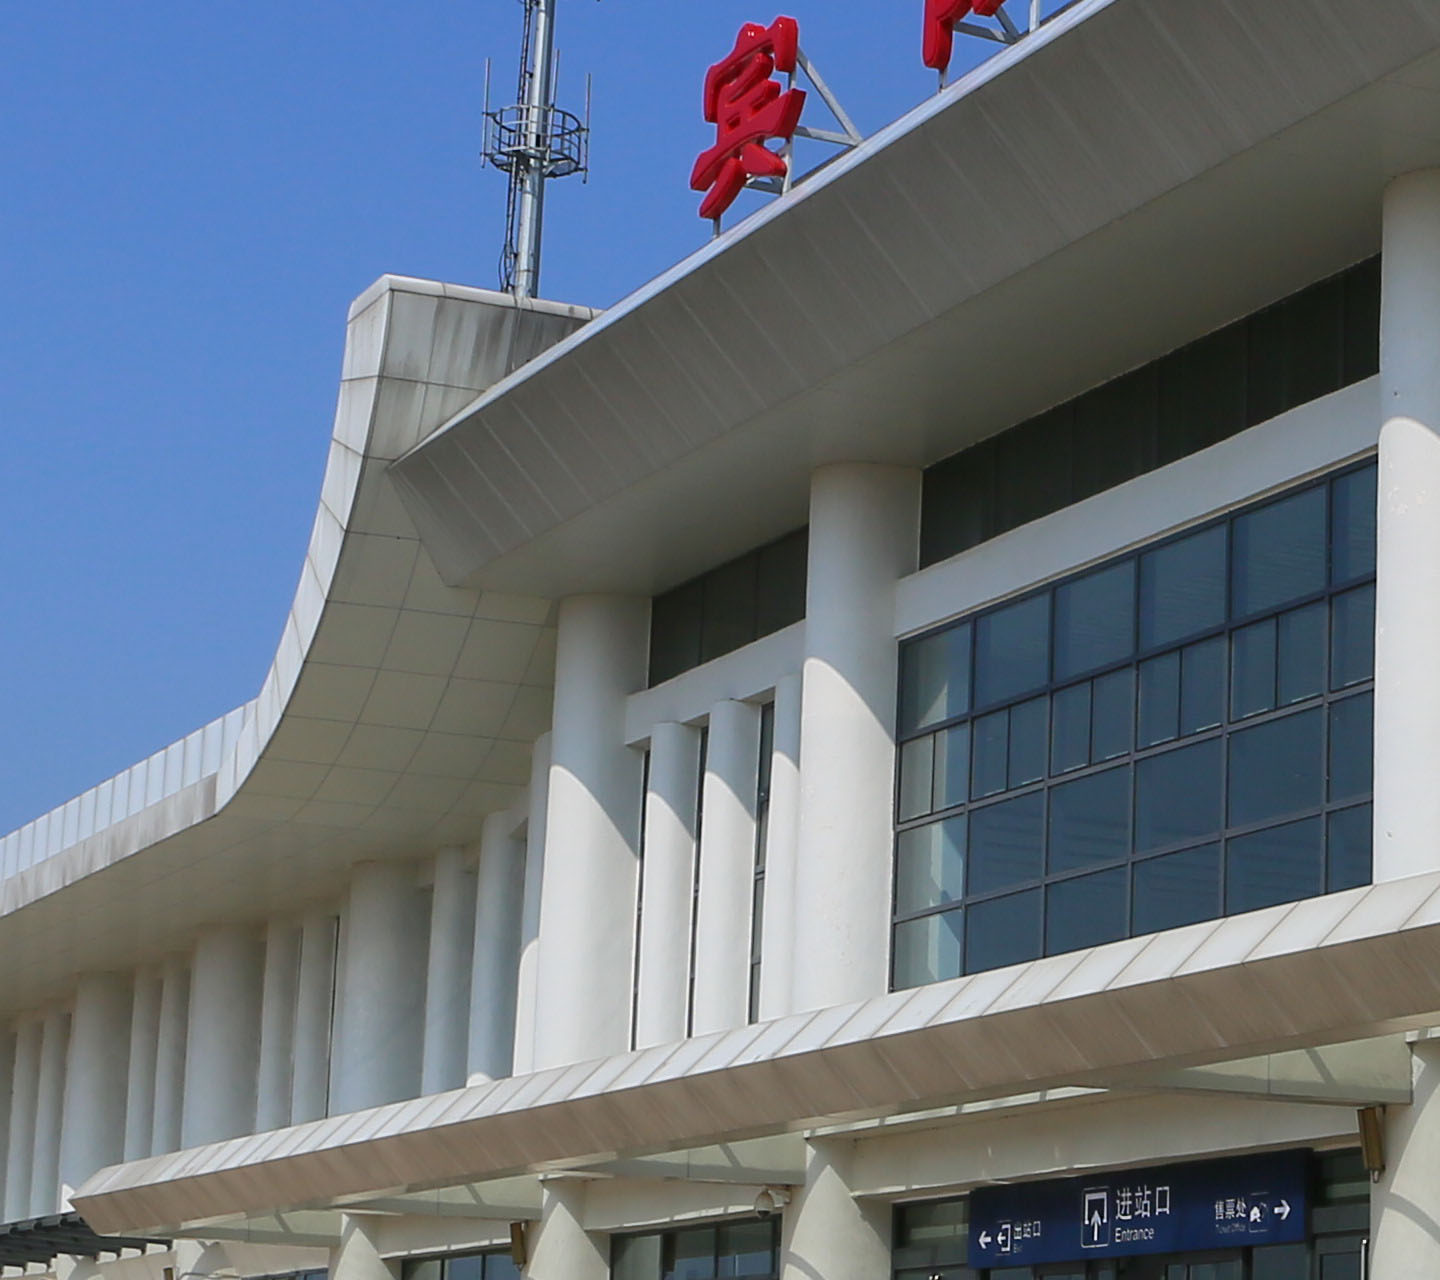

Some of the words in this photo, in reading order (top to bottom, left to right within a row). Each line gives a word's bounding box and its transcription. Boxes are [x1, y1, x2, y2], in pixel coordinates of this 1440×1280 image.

[1115, 1185, 1170, 1220] 进站口
[1215, 1197, 1247, 1220] 售票处
[1115, 1227, 1155, 1242] Entrance
